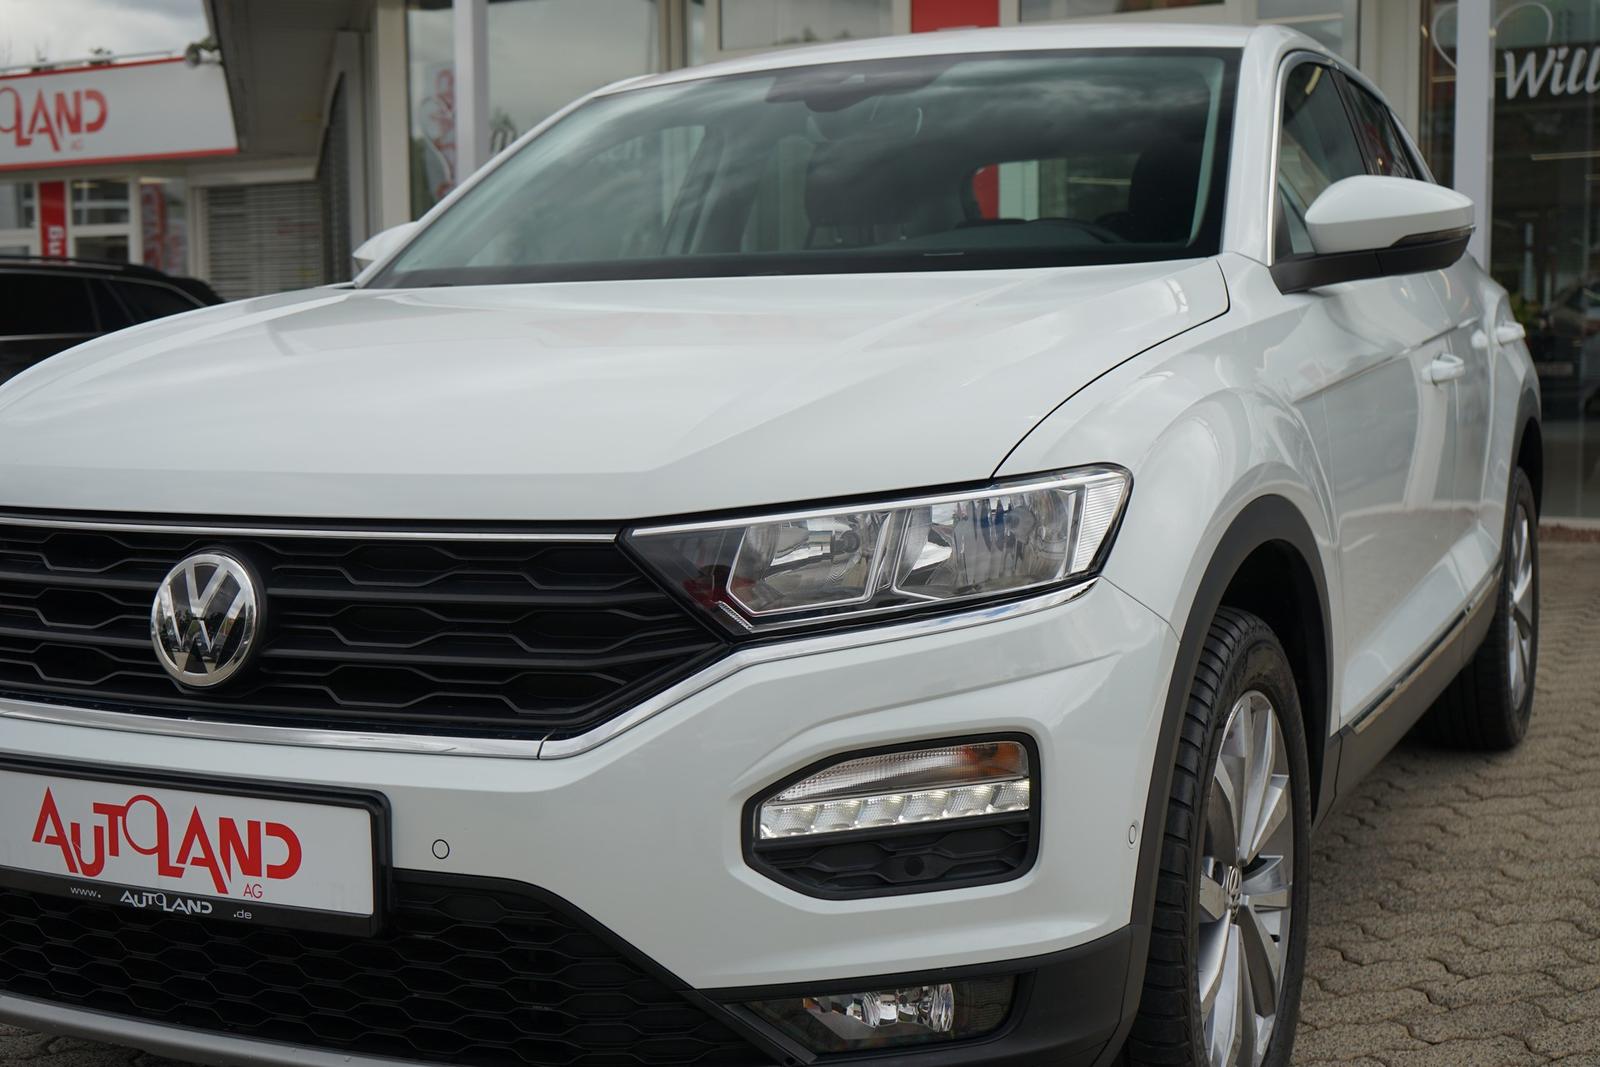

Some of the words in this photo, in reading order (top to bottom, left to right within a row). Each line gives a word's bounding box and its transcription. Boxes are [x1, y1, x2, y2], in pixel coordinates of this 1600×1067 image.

[1503, 45, 1600, 99] Will
[32, 786, 302, 894] AUTOLAND
[70, 886, 102, 898] www.
[120, 890, 213, 915] AUTOLAND
[233, 909, 252, 919] .de
[243, 883, 263, 899] AG
